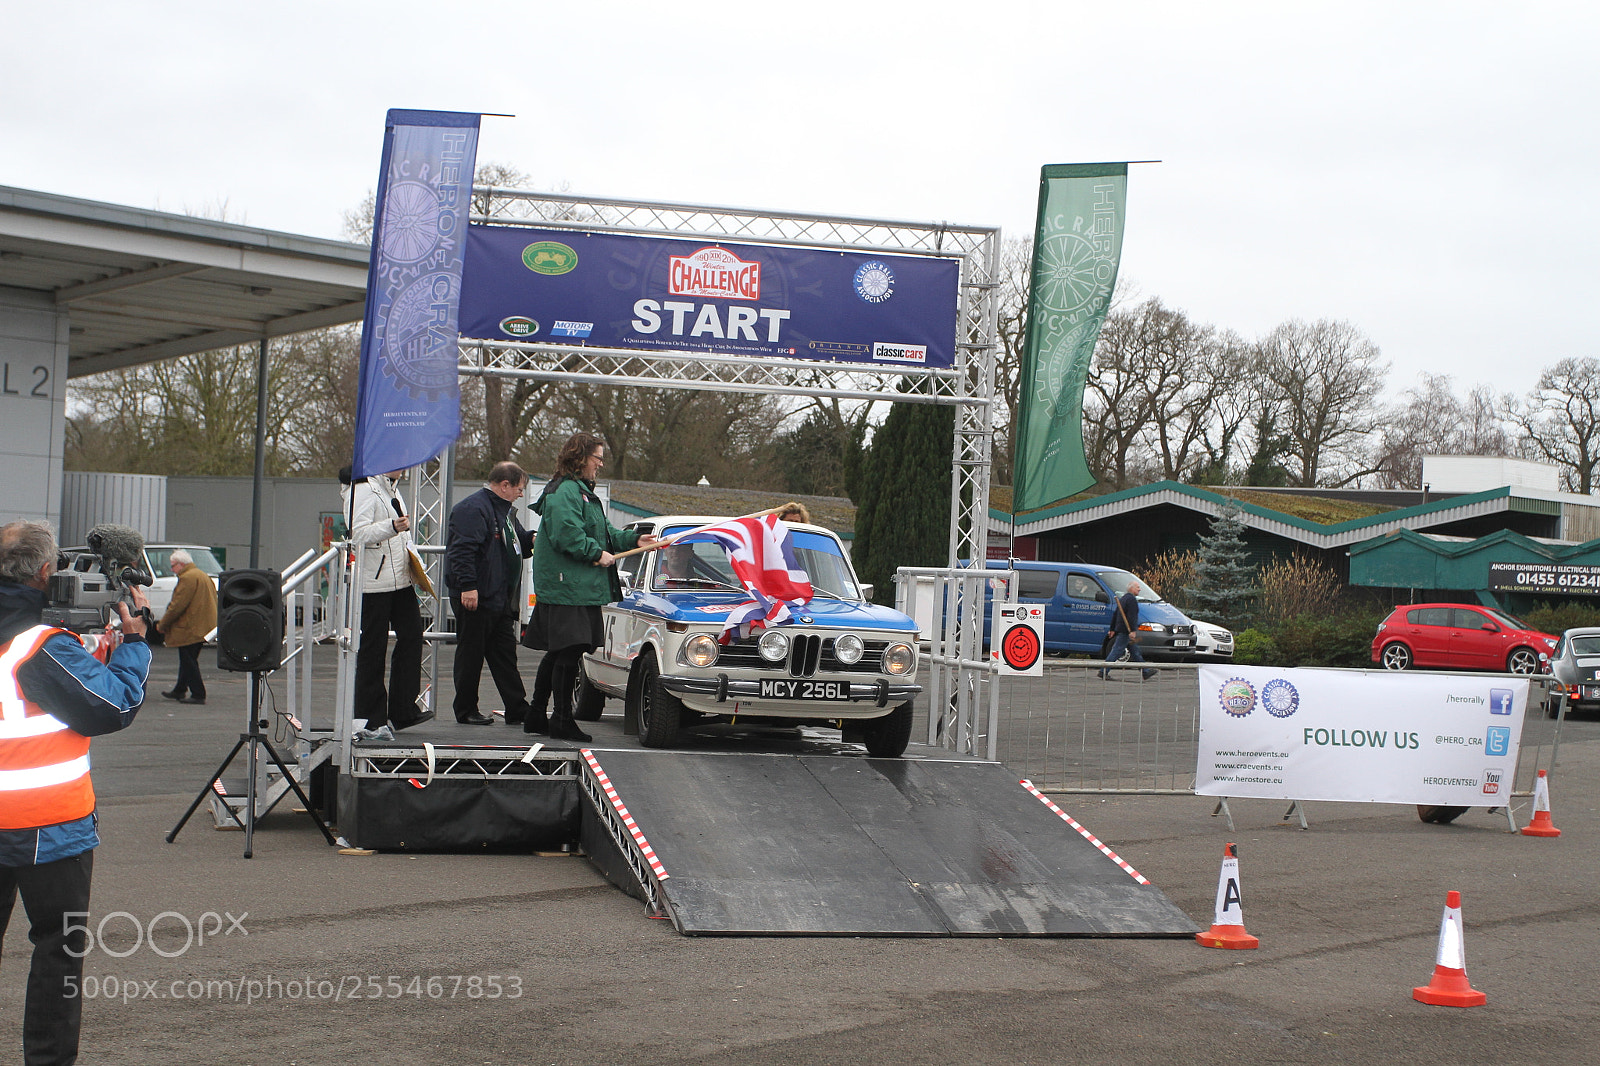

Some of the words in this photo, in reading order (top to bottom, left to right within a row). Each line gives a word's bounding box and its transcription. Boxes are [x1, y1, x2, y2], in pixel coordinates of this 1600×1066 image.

[437, 133, 467, 238] HERO
[1092, 183, 1115, 287] HERO
[702, 262, 725, 270] Winter
[856, 262, 877, 283] CLASSIC
[878, 264, 895, 284] RALLY
[672, 259, 758, 298] CHALLENGE
[856, 286, 894, 303] ASSOCIATION
[426, 274, 452, 356] CRA
[631, 298, 791, 343] START
[555, 320, 592, 330] MOTORS
[31, 365, 49, 397] 2
[1491, 563, 1516, 571] ANCHOR
[1516, 564, 1552, 572] EXHIBITIONS
[1557, 565, 1590, 573] ELECTRICAL
[1516, 572, 1555, 585] 01455
[761, 680, 798, 698] MCY
[801, 682, 849, 699] 256L
[1263, 680, 1281, 699] CLASSIC
[1282, 681, 1298, 699] RALLY
[1446, 693, 1485, 706] /herorally
[1265, 701, 1298, 717] ASSOCIATION
[1303, 727, 1388, 748] FOLLOW
[1394, 731, 1420, 750] US
[1435, 735, 1483, 747] @HERO_CRA
[1215, 749, 1290, 759] www.heroevents.eu
[1214, 762, 1284, 771] www.craevents.eu
[1213, 774, 1284, 784] www.herostore.eu
[1423, 776, 1478, 787] HEROEVENTSEU
[1486, 772, 1500, 783] You
[1222, 877, 1242, 913] A
